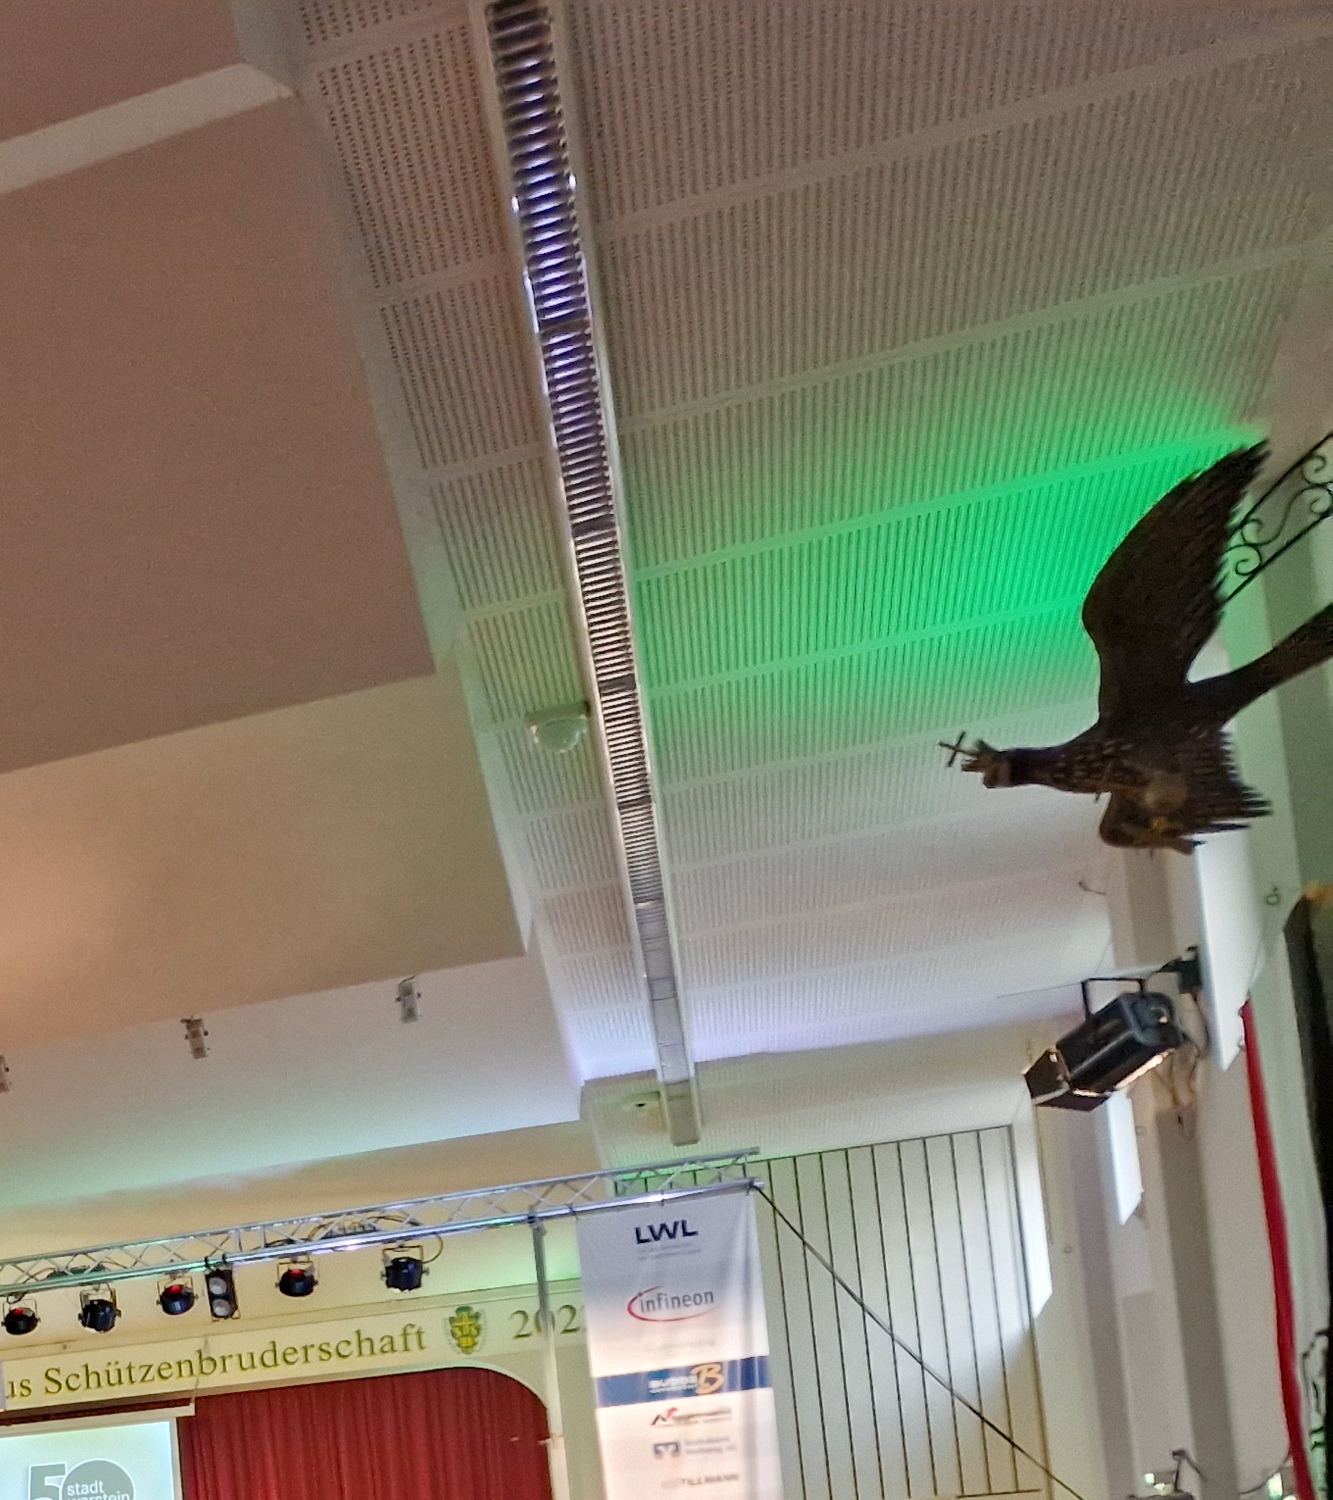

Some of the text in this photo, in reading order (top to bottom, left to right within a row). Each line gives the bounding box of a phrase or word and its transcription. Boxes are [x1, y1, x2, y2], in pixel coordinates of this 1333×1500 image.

[635, 1220, 698, 1244] LWL
[639, 1290, 714, 1313] infineon
[44, 1322, 426, 1396] Schützenbruderschaft
[507, 1304, 586, 1339] 202
[67, 1479, 104, 1496] stadt
